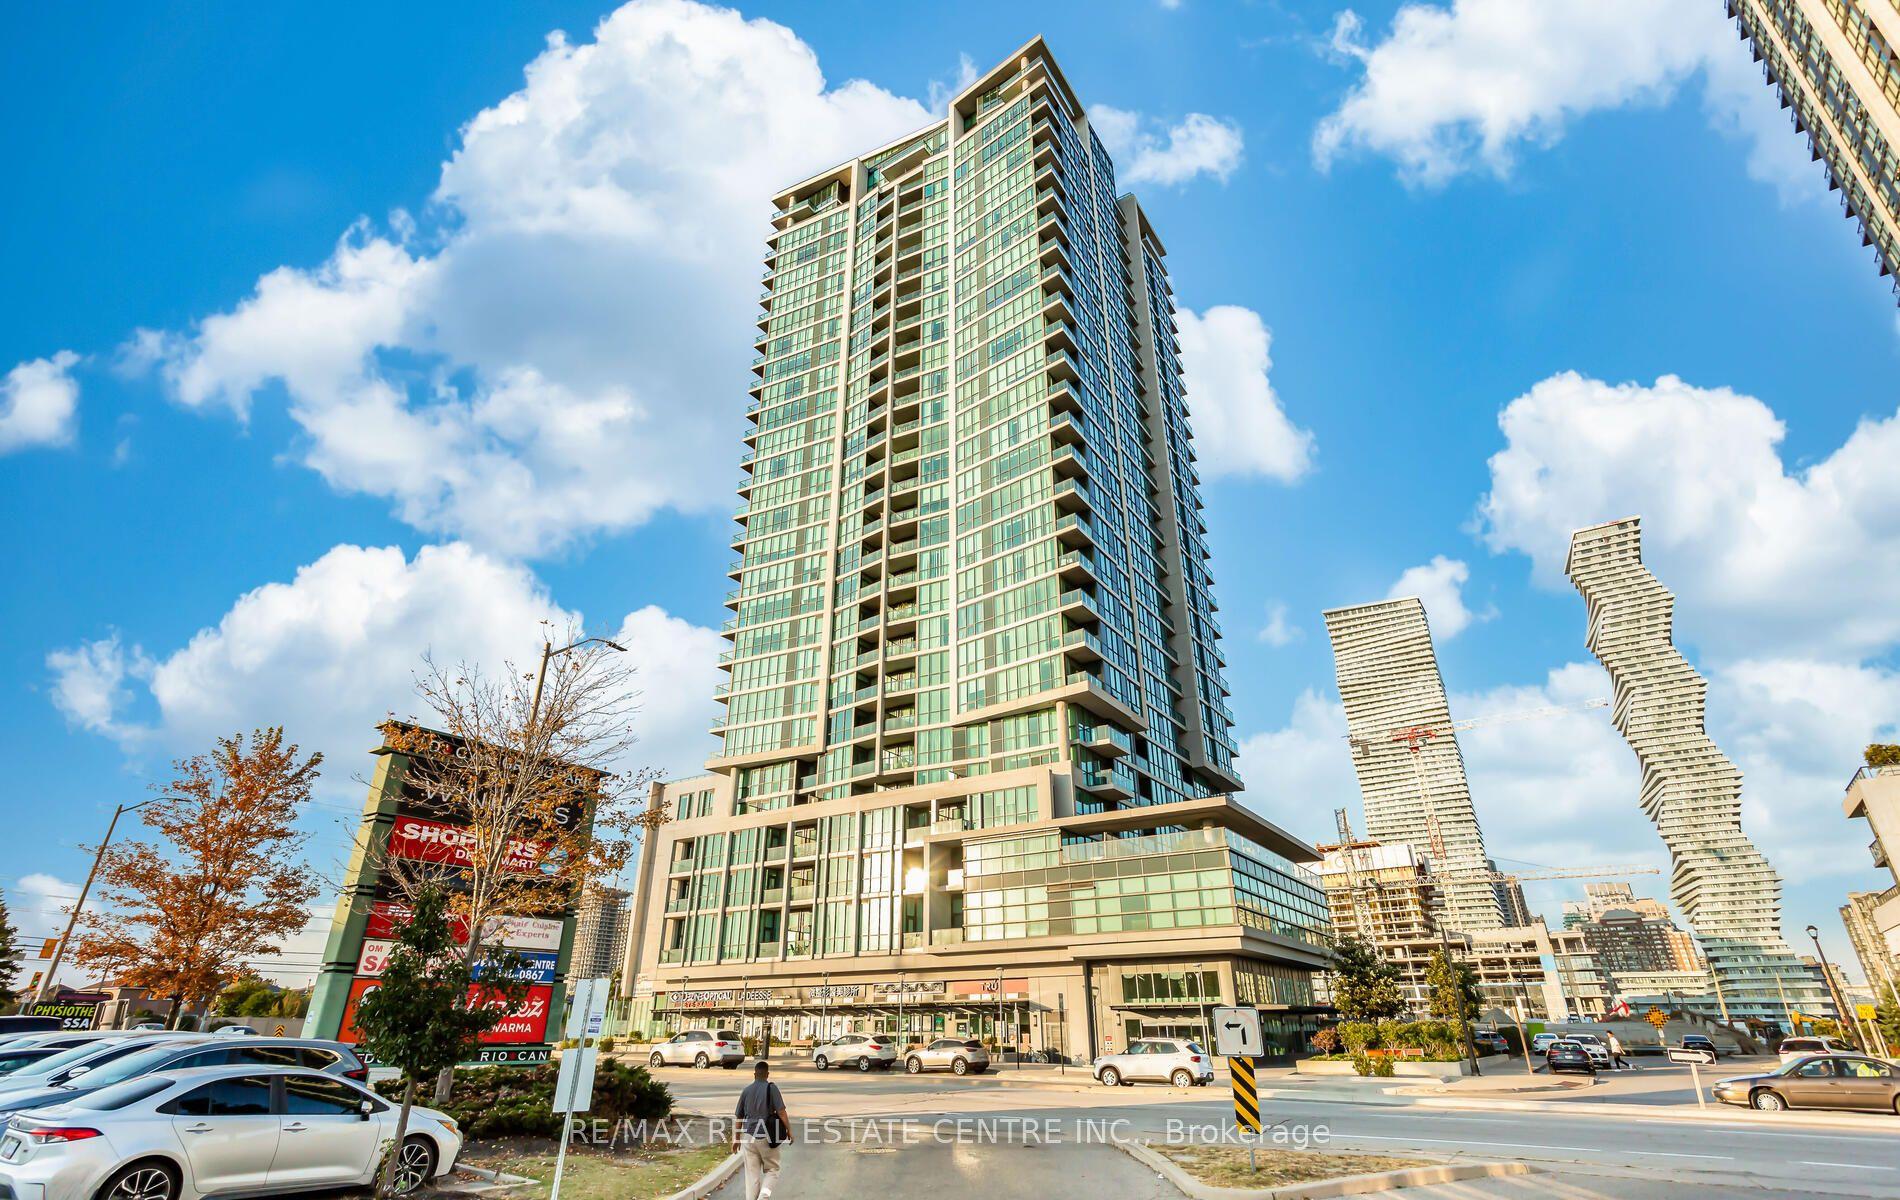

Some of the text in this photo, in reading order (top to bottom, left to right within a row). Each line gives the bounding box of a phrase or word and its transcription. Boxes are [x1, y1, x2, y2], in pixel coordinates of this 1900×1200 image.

[400, 823, 539, 858] SHOPRS
[516, 929, 550, 939] Experts
[528, 960, 556, 970] ENTRE
